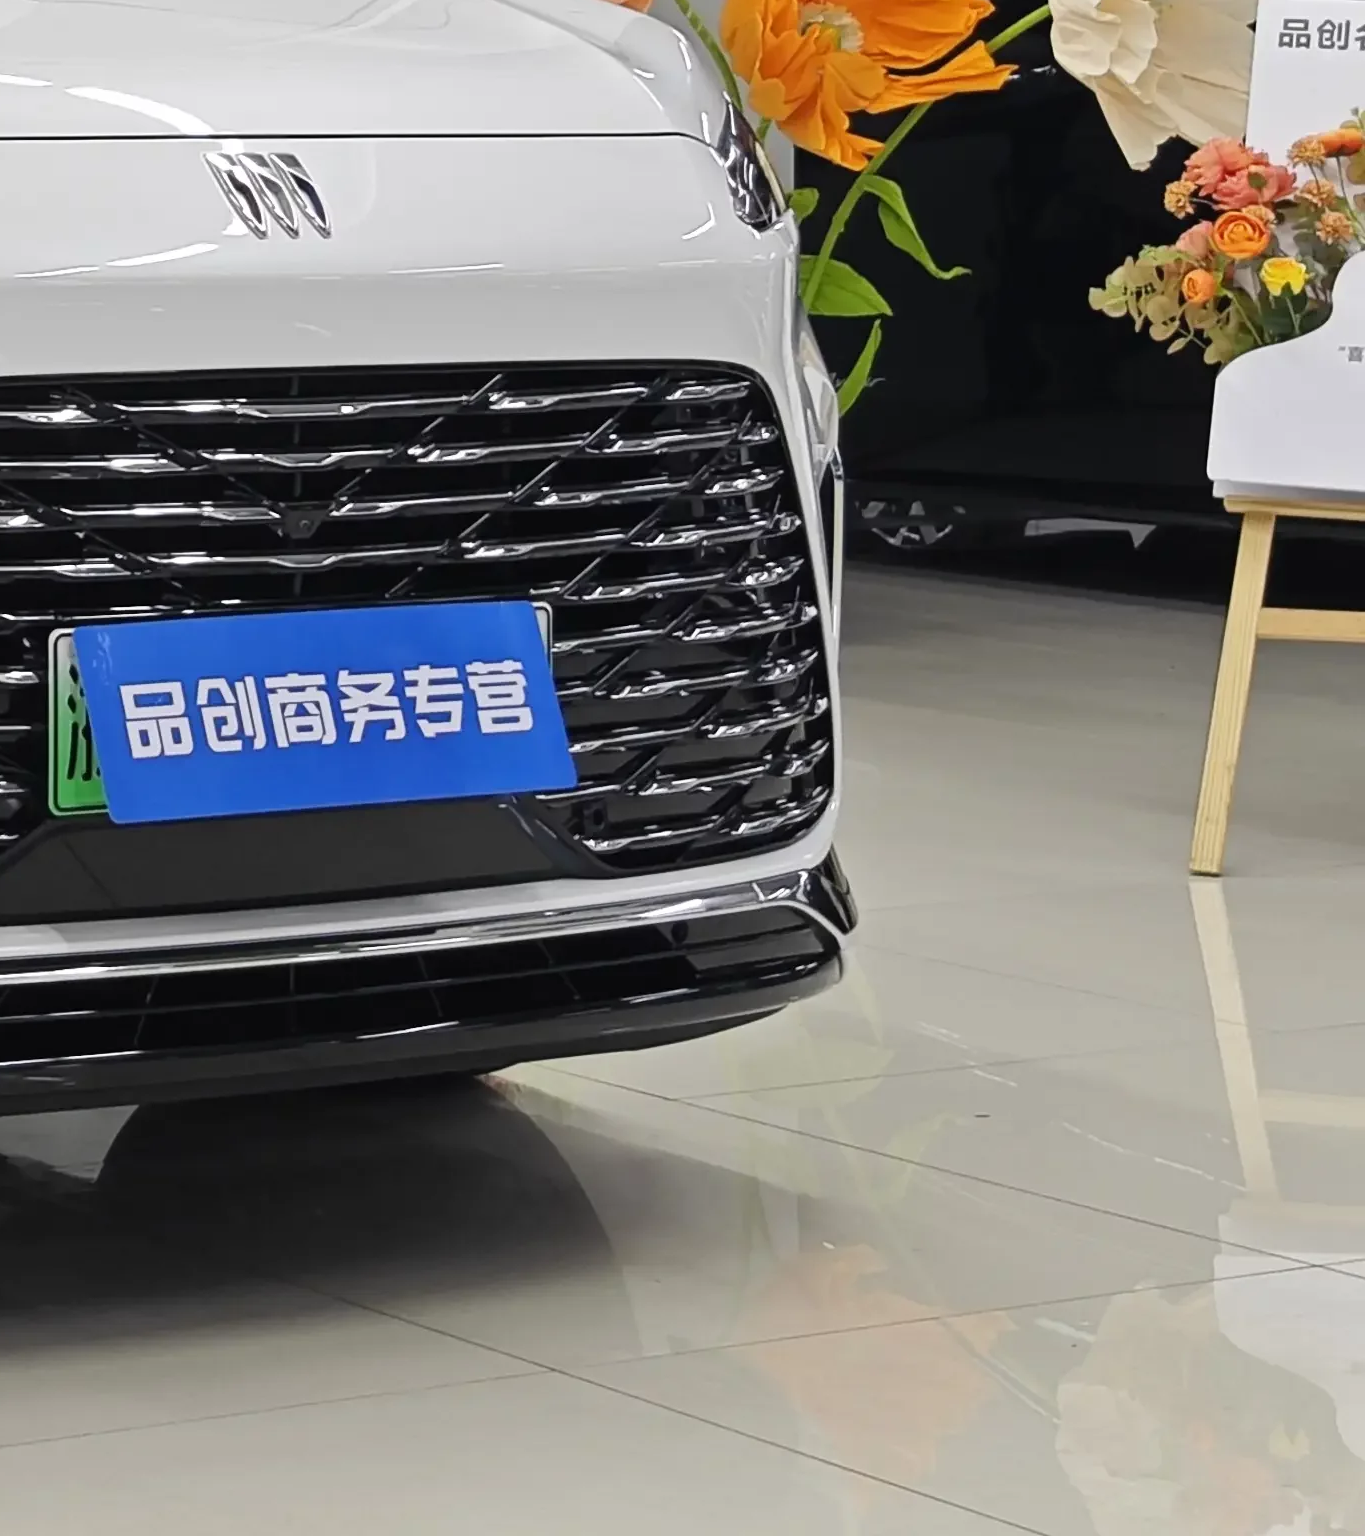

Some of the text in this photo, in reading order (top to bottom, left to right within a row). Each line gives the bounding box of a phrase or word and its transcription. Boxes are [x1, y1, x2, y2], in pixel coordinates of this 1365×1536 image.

[118, 658, 535, 761] 品创商务专营
